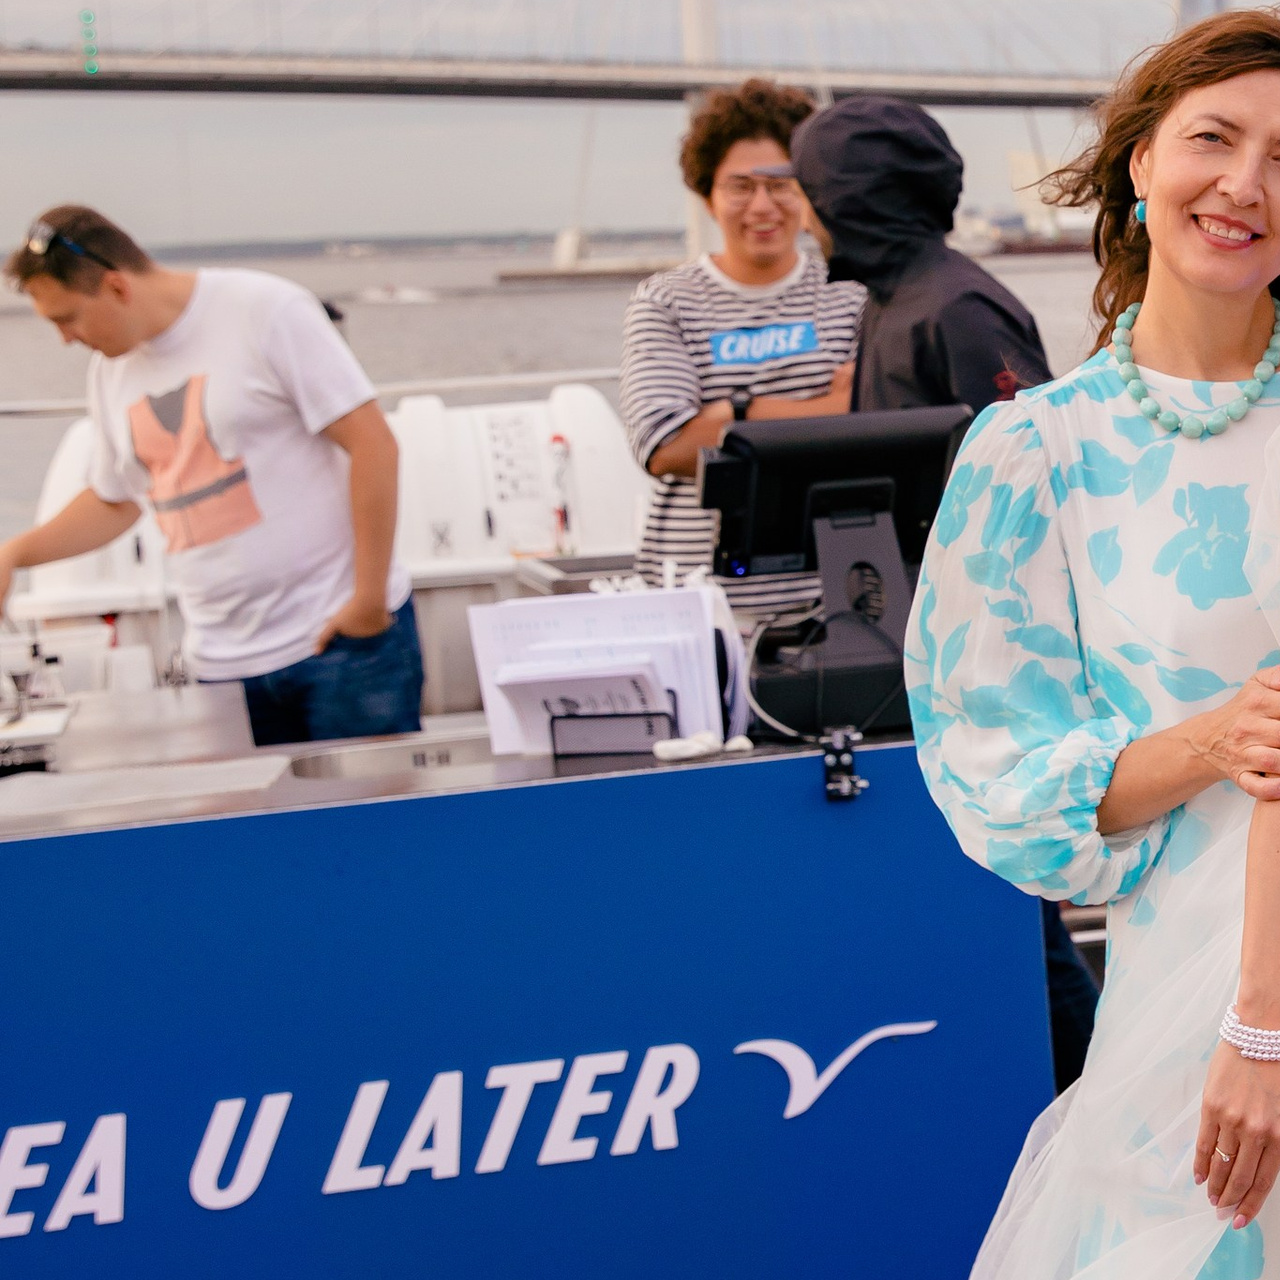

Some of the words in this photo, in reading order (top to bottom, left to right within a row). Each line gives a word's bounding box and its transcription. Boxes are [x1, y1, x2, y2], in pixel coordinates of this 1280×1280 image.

[720, 324, 806, 360] CRUISE
[188, 1091, 293, 1211] U
[321, 1043, 700, 1195] LATER
